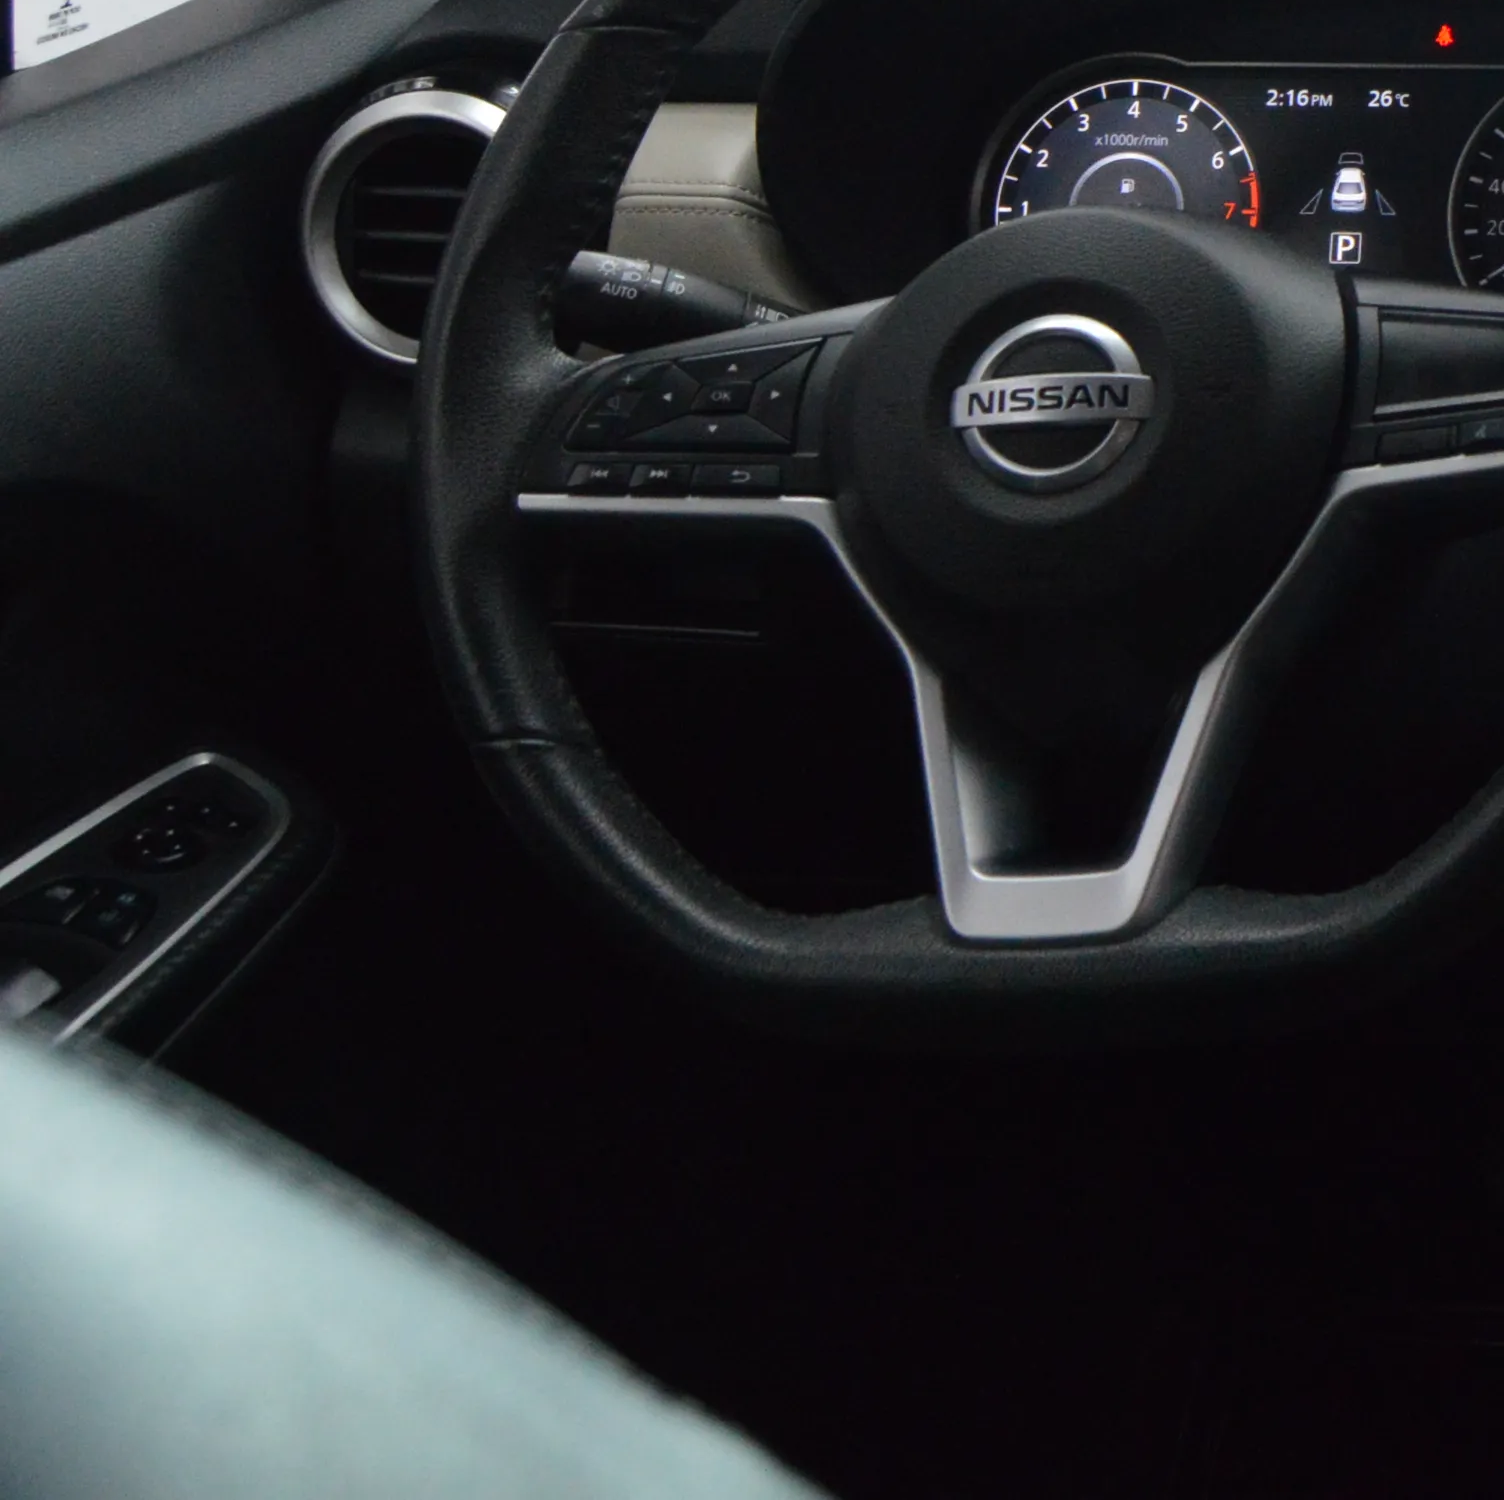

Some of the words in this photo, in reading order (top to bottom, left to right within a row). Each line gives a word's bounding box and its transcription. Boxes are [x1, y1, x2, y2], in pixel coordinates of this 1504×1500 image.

[1127, 100, 1141, 118] 4
[1077, 114, 1090, 132] 3
[1176, 114, 1189, 133] 5
[1095, 134, 1169, 147] x1000r/min
[1036, 150, 1049, 168] 2
[1211, 151, 1225, 170] 6
[1020, 200, 1030, 217] 1
[1223, 202, 1237, 220] 7
[600, 281, 638, 300] AUTO
[710, 389, 732, 402] OK
[967, 383, 1130, 417] NISSAN
